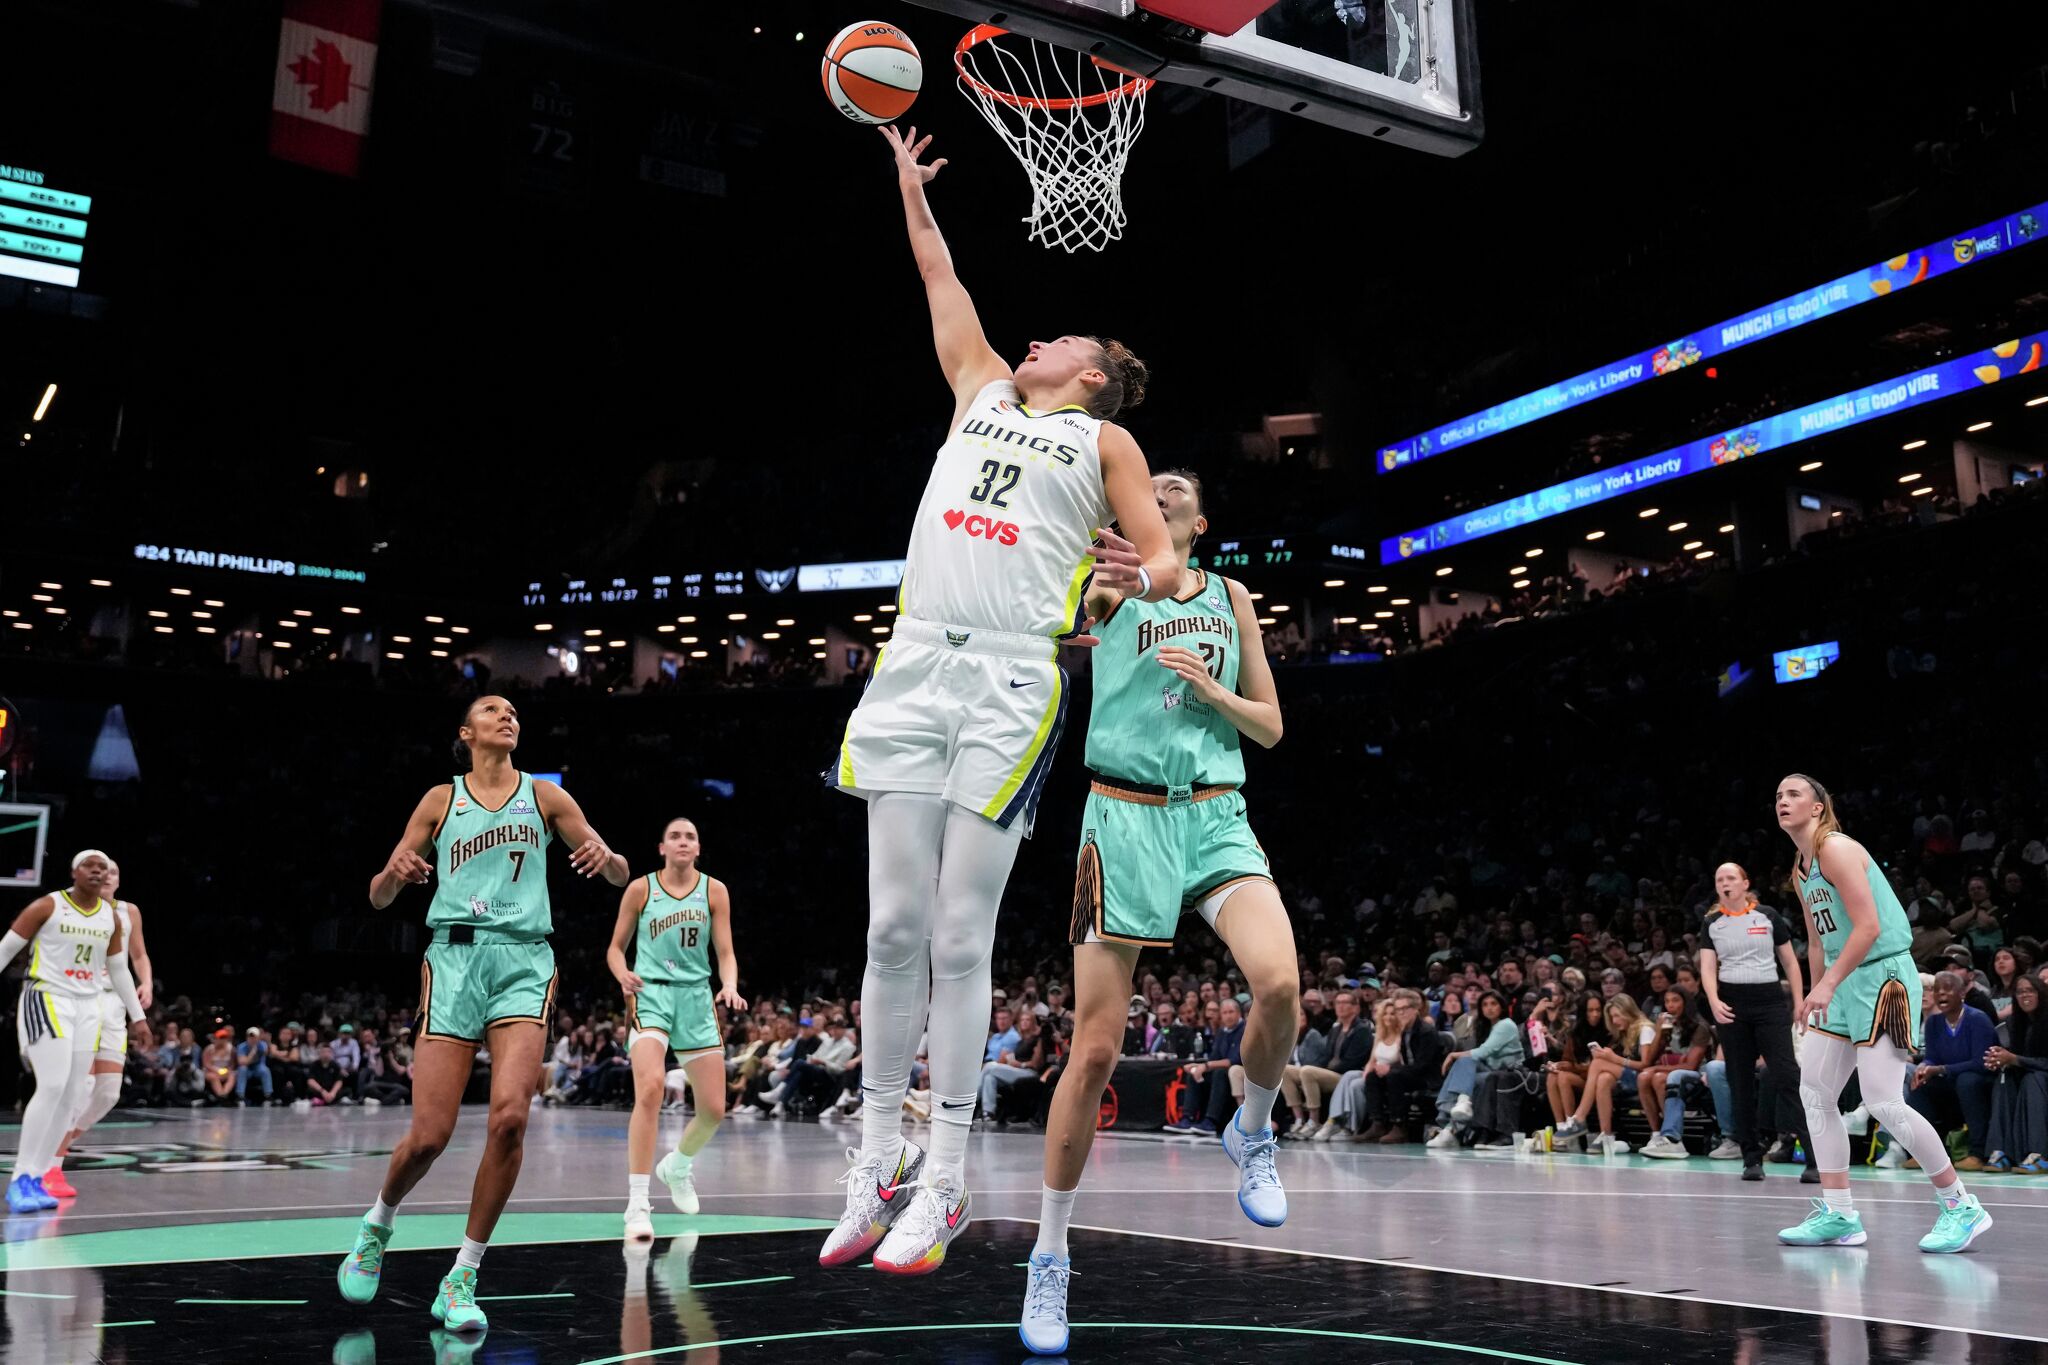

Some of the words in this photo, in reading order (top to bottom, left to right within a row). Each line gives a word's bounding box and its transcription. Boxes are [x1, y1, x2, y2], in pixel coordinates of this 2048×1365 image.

[1721, 312, 1773, 347] MUNCH
[1787, 295, 1820, 321] GOOD
[1820, 283, 1849, 307] VIBE
[1439, 424, 1475, 447] Official
[1543, 391, 1569, 409] New
[1571, 380, 1598, 399] York
[1599, 363, 1643, 390] Liberty
[1799, 400, 1855, 434] MUNCH
[1871, 384, 1908, 411] GOOD
[1907, 372, 1940, 397] VIBE
[1059, 417, 1092, 437] Albert
[970, 459, 1024, 511] 32
[1463, 513, 1501, 534] Official
[1574, 483, 1602, 500] New
[1604, 472, 1633, 490] York
[1635, 457, 1682, 483] Liberty
[965, 514, 1021, 546] CVS
[1272, 539, 1286, 549] FT
[134, 544, 170, 562] #24
[173, 548, 215, 567] TARI
[218, 553, 296, 576] PHILLIPS
[1213, 553, 1249, 568] 2/12
[1265, 550, 1293, 564] 7/7
[734, 571, 743, 581] 4
[523, 594, 546, 606] 1/1
[560, 591, 592, 604] 4/14
[600, 588, 638, 602] 16/37
[653, 587, 669, 600] 21
[686, 586, 700, 598] 12
[1137, 616, 1233, 656] BROOKLYN
[510, 807, 535, 815] BARCLAYS
[450, 824, 539, 875] BROOKLYN
[509, 850, 527, 883] 7
[491, 900, 519, 909] Liberty
[491, 907, 523, 917] Mutual
[60, 923, 110, 940] WINGS
[649, 909, 708, 941] BROOKLYN
[1813, 908, 1837, 936] 20
[680, 927, 699, 948] 18
[74, 943, 93, 964] 24
